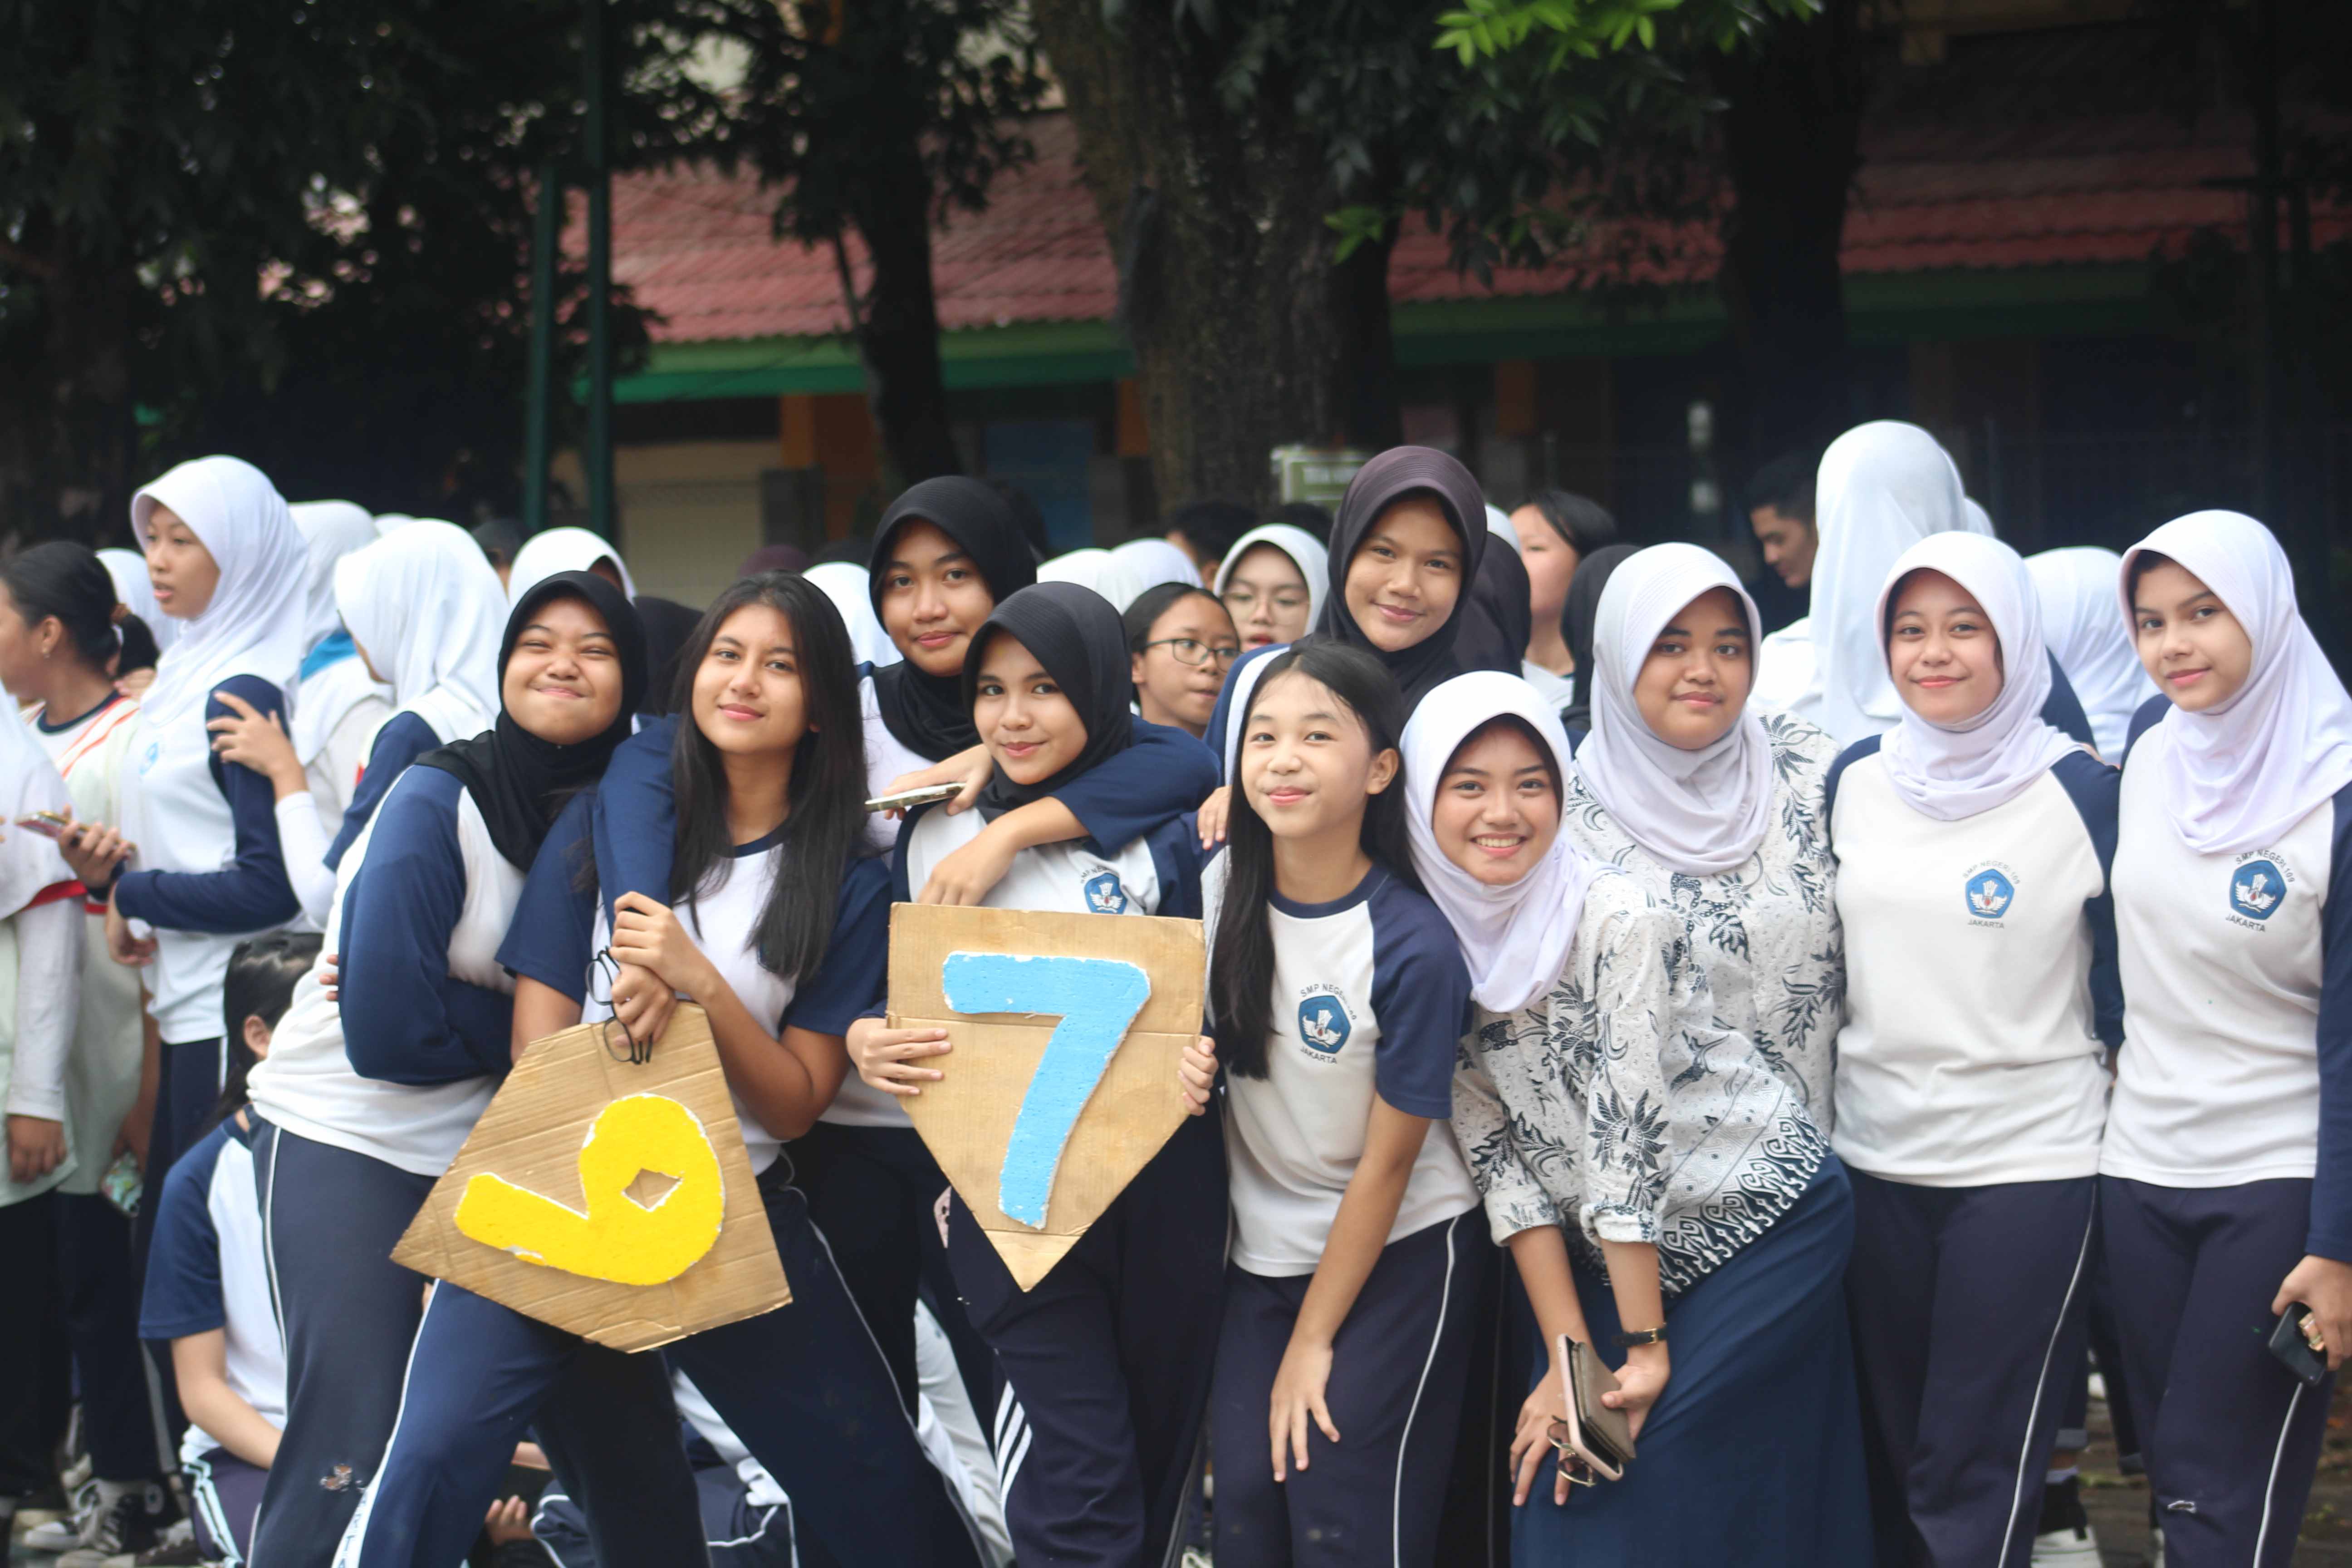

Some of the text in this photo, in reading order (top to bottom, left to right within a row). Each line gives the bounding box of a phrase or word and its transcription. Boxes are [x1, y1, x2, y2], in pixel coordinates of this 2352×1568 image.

[2257, 849, 2287, 868] NEGERI
[1962, 864, 1978, 878] SMP
[1980, 860, 2011, 872] NEGERI
[1967, 919, 2005, 929] JAKARTA
[2225, 913, 2266, 932] JAKARTA
[1300, 984, 1319, 997] SMP
[1300, 1046, 1338, 1064] JAKARTA
[942, 951, 1152, 1230] 7
